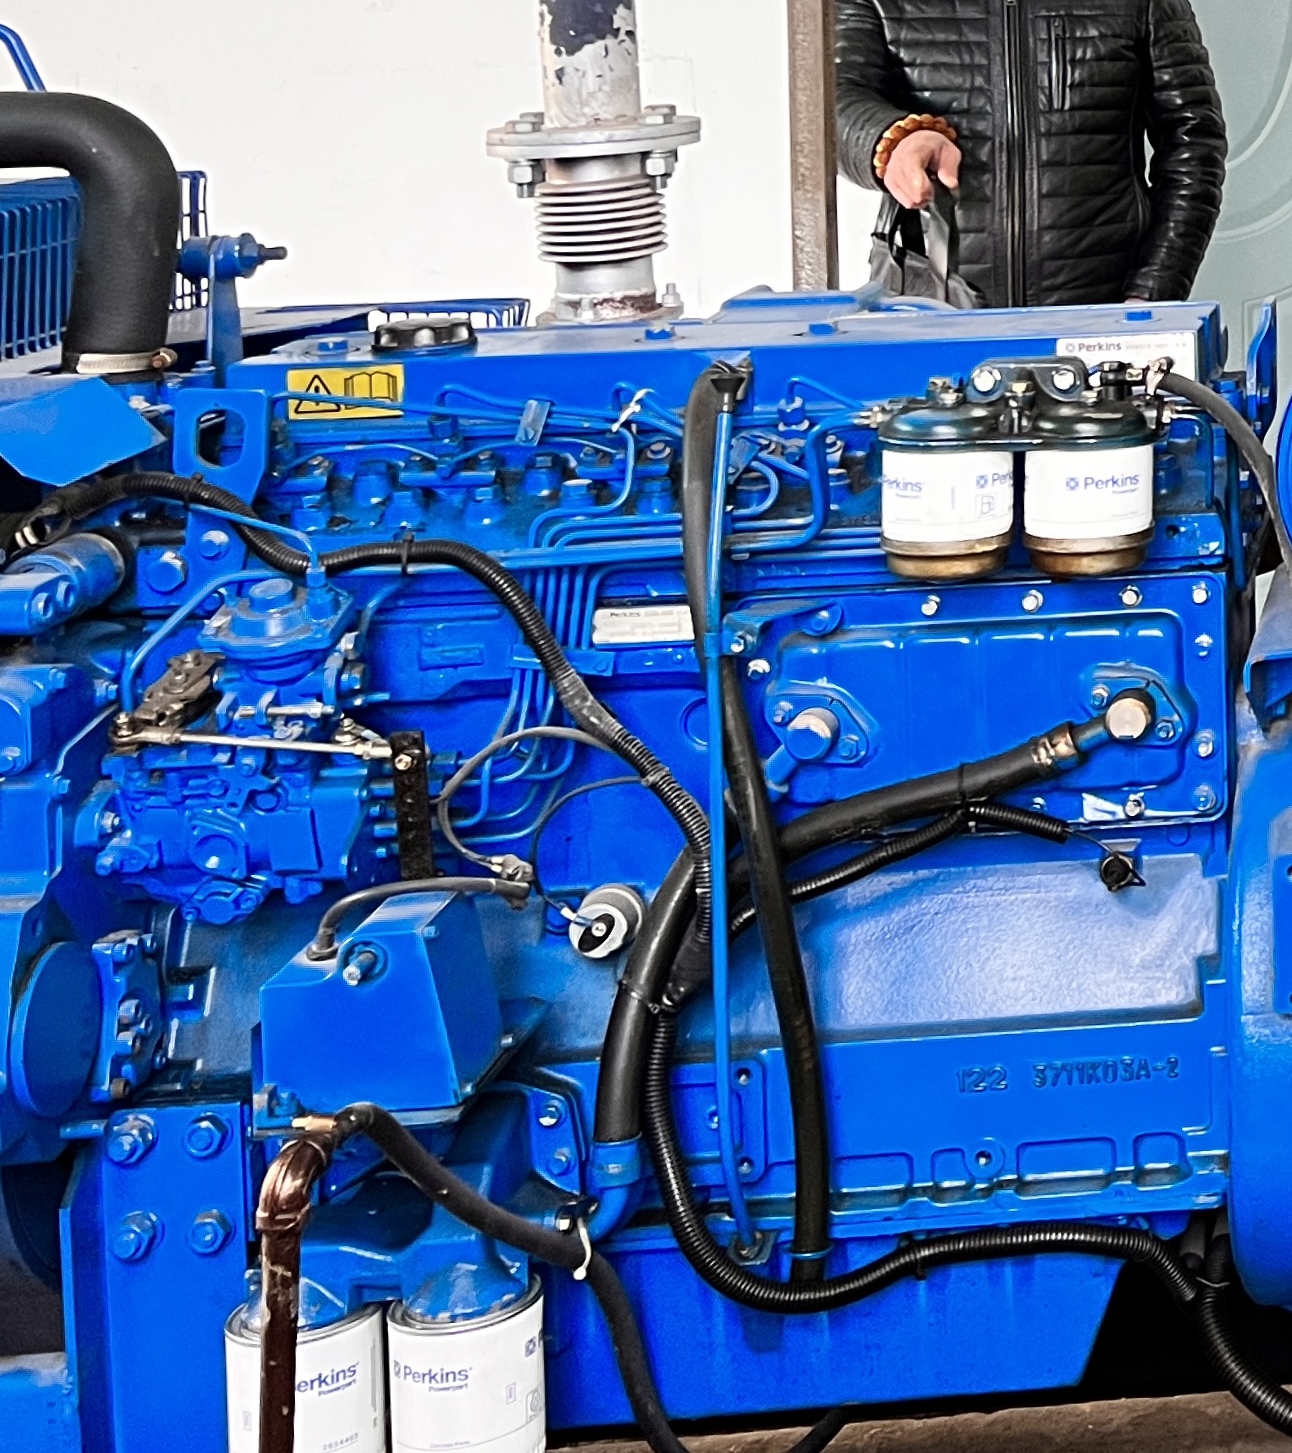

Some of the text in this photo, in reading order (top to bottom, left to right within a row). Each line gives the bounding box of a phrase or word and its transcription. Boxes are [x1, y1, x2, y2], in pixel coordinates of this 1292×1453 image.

[1078, 342, 1122, 352] Perkins
[1084, 474, 1139, 490] Perkins
[296, 1362, 358, 1393] erkins
[403, 1365, 470, 1384] Perkins
